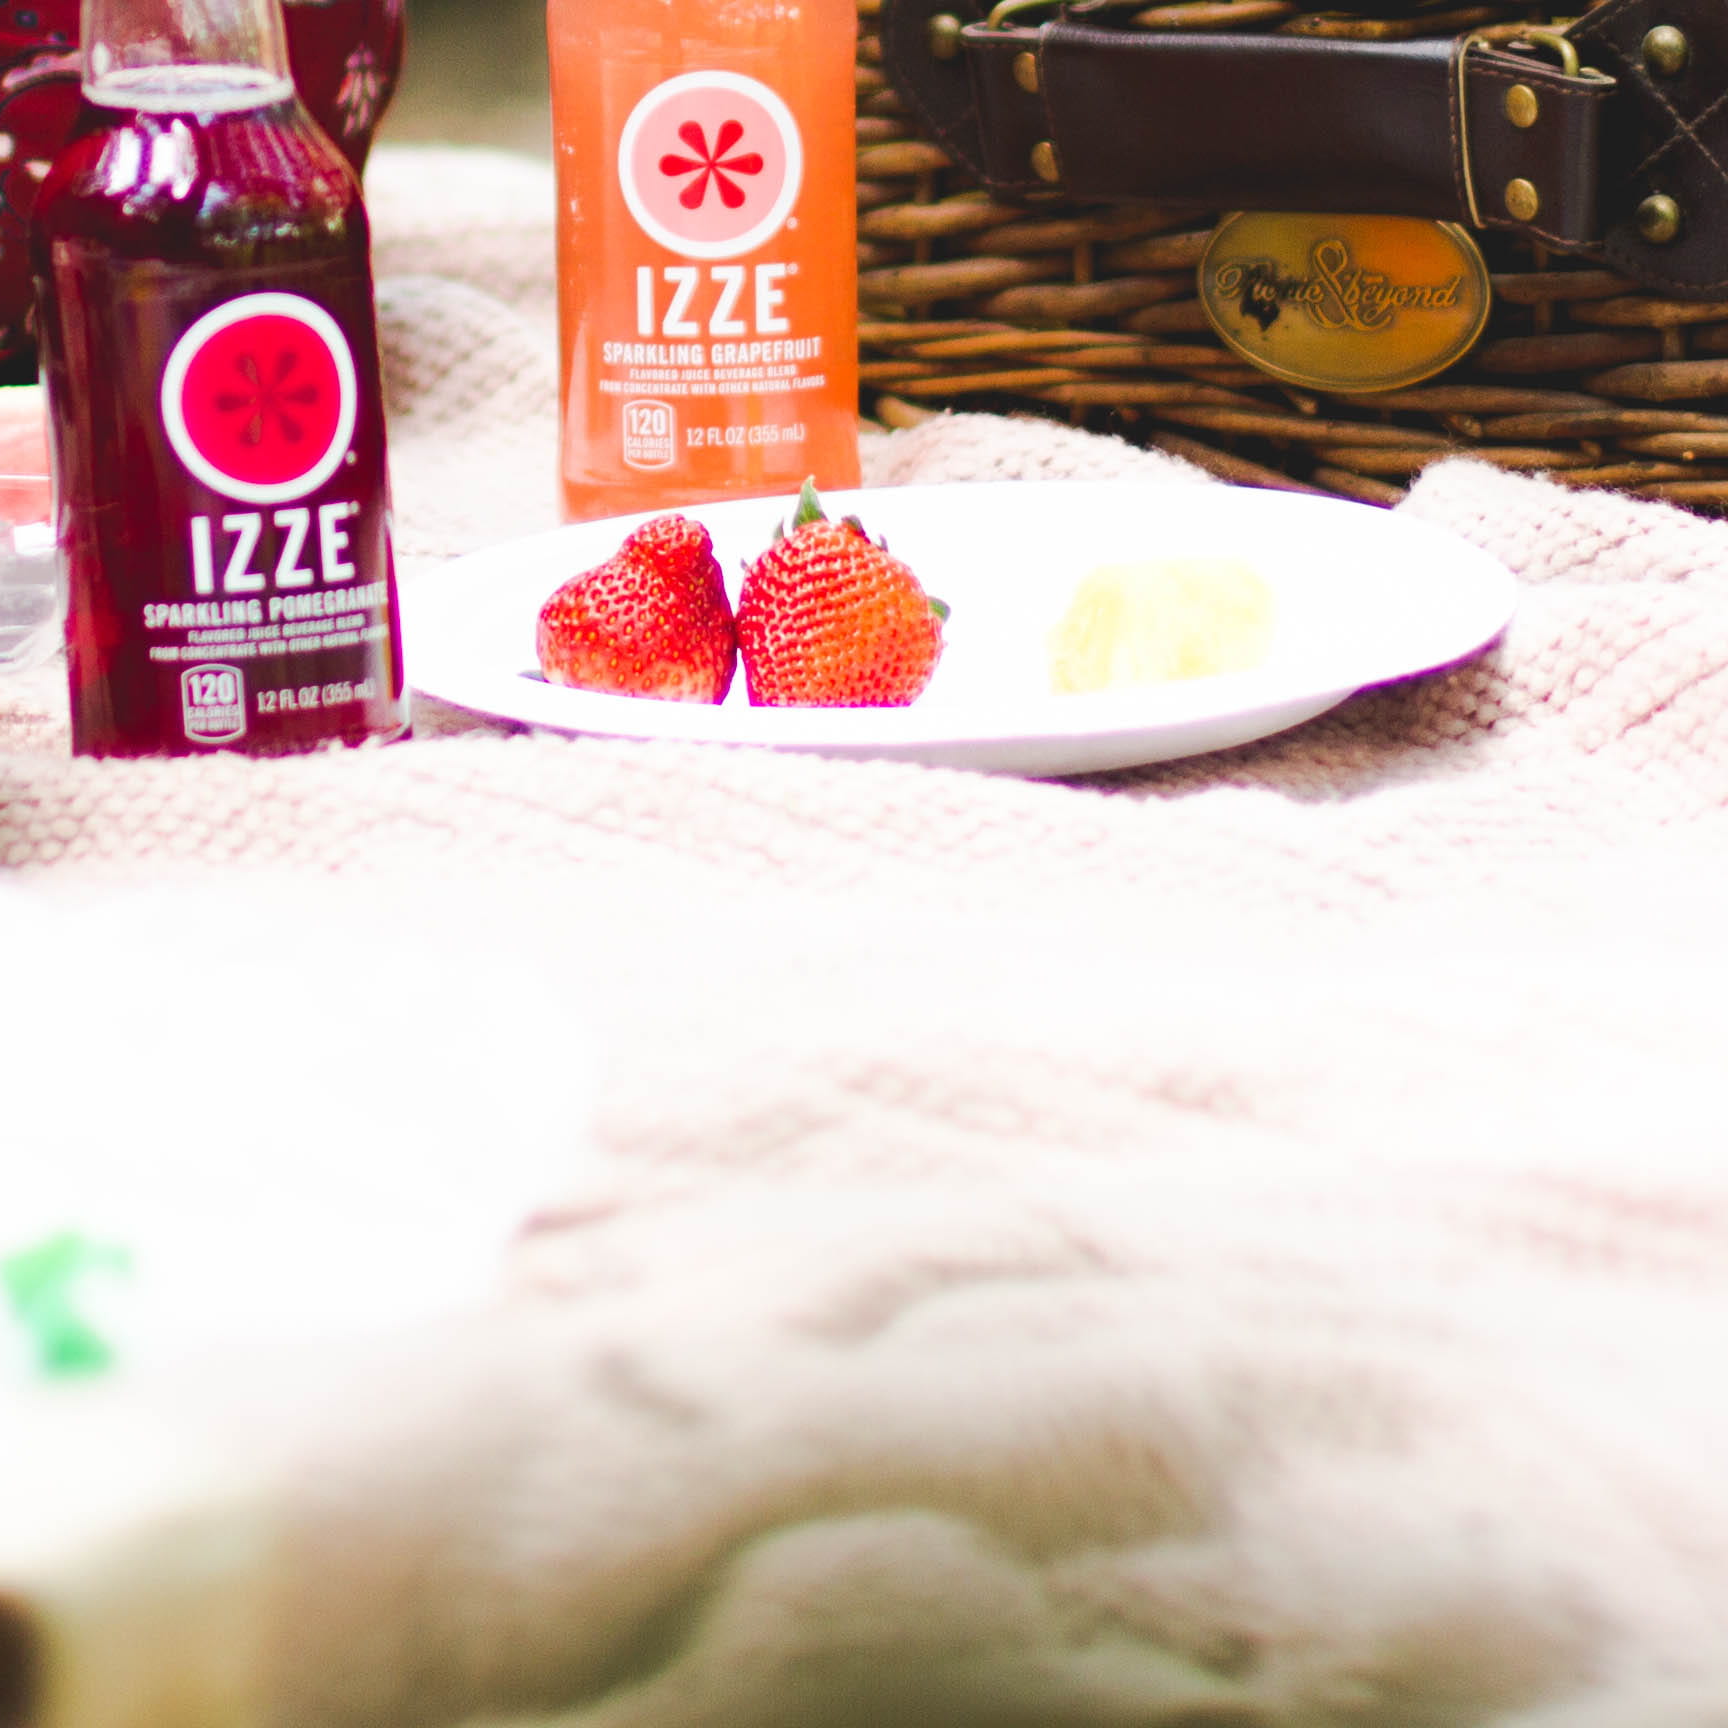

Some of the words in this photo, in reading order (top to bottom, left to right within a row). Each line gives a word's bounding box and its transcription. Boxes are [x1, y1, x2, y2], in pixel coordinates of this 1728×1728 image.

[1313, 239, 1392, 331] &
[636, 263, 790, 337] IZZE
[602, 341, 704, 366] SPARKLING
[711, 336, 822, 365] GRAPEFRUIT
[623, 381, 689, 395] CONCENTRATE
[691, 382, 716, 395] WITH
[718, 381, 751, 395] OTHER
[752, 379, 791, 393] NATURAL
[629, 368, 678, 381] FLAVORED
[680, 368, 710, 381] JUICE
[714, 366, 764, 381] BEVERAGE
[767, 364, 798, 378] BLEND
[629, 408, 667, 436] 120
[686, 427, 704, 447] 12
[725, 426, 745, 445] OZ
[748, 425, 779, 446] (355
[191, 502, 355, 594] IZZE
[143, 599, 263, 628] SPARKLING
[189, 673, 235, 705] 120
[257, 691, 277, 713] 12
[298, 685, 319, 707] OZ
